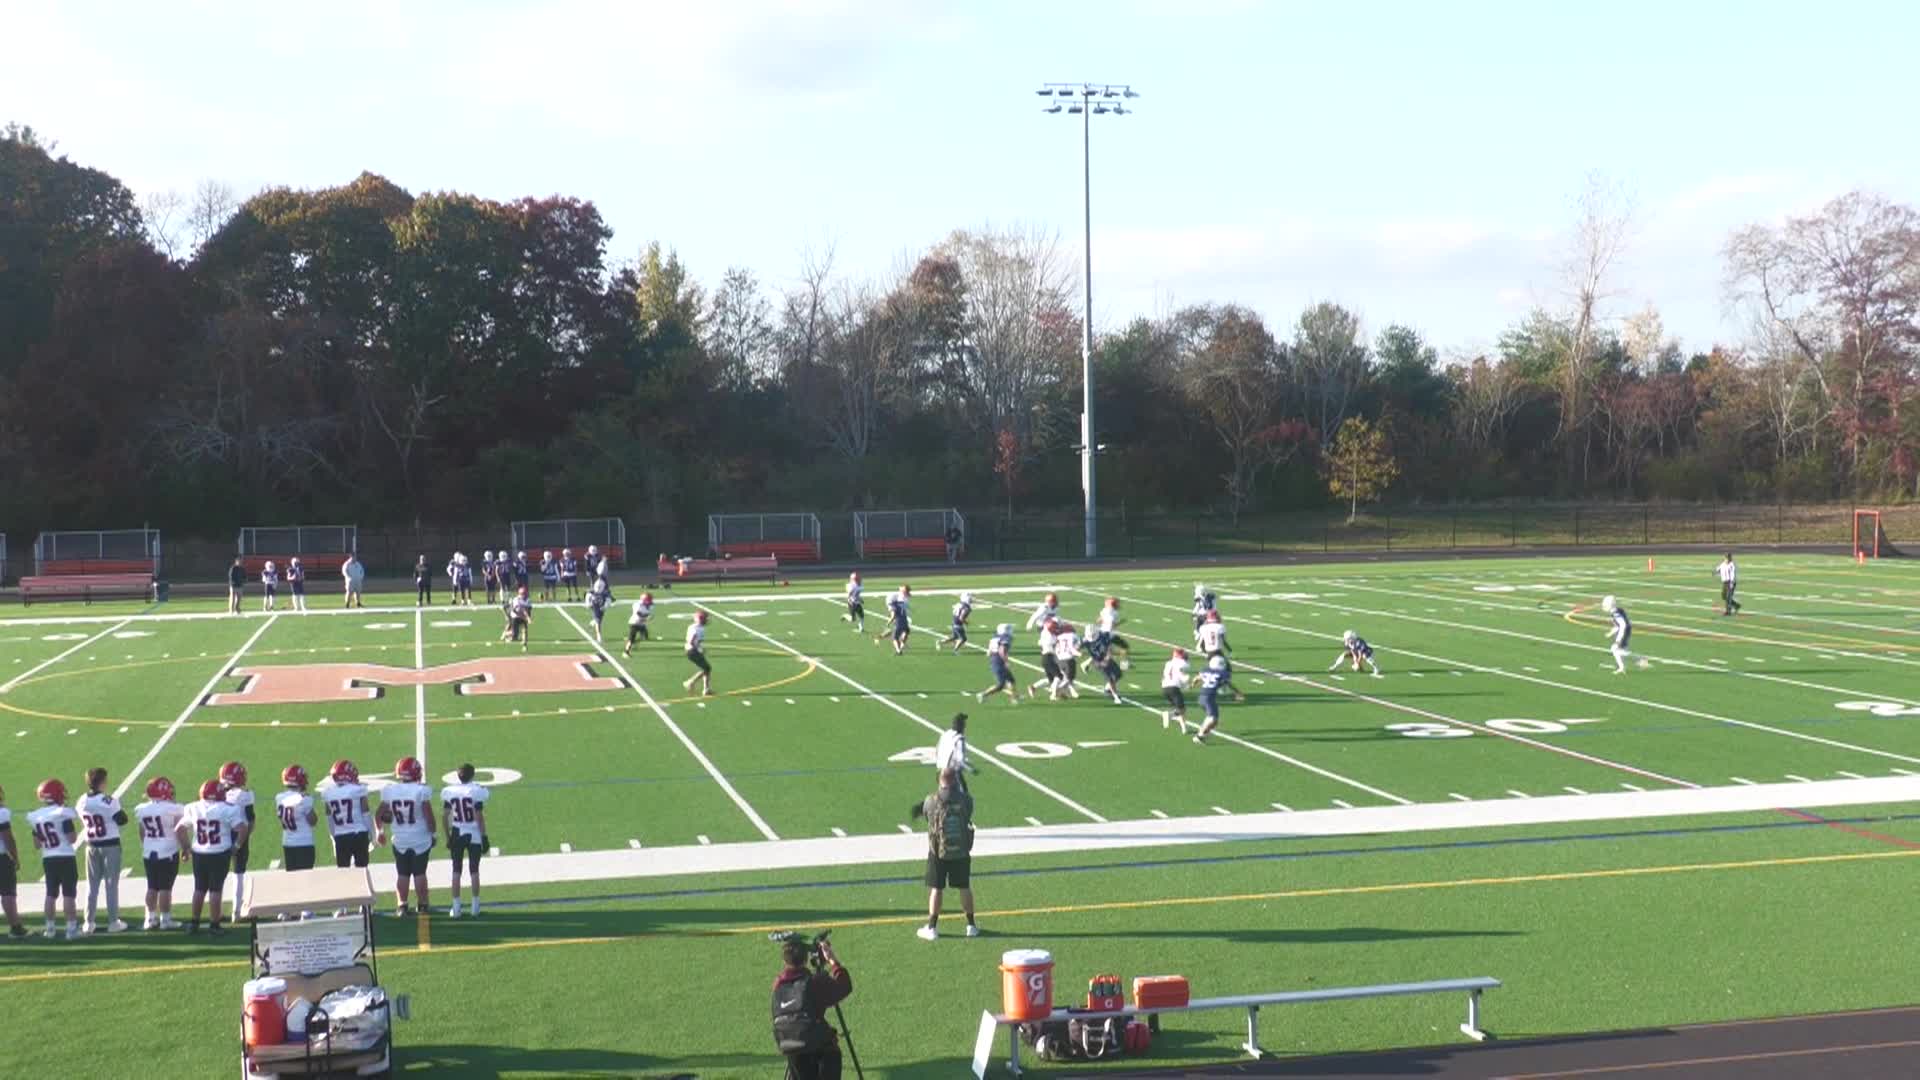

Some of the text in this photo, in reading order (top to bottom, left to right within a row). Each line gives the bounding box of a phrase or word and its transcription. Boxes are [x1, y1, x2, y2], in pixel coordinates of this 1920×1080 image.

[330, 799, 354, 825] 27
[391, 800, 416, 824] 67
[450, 797, 475, 823] 36
[82, 814, 107, 838] 28
[142, 815, 165, 838] 51
[196, 819, 221, 845] 62
[1029, 973, 1043, 990] G
[1104, 999, 1113, 1009] G
